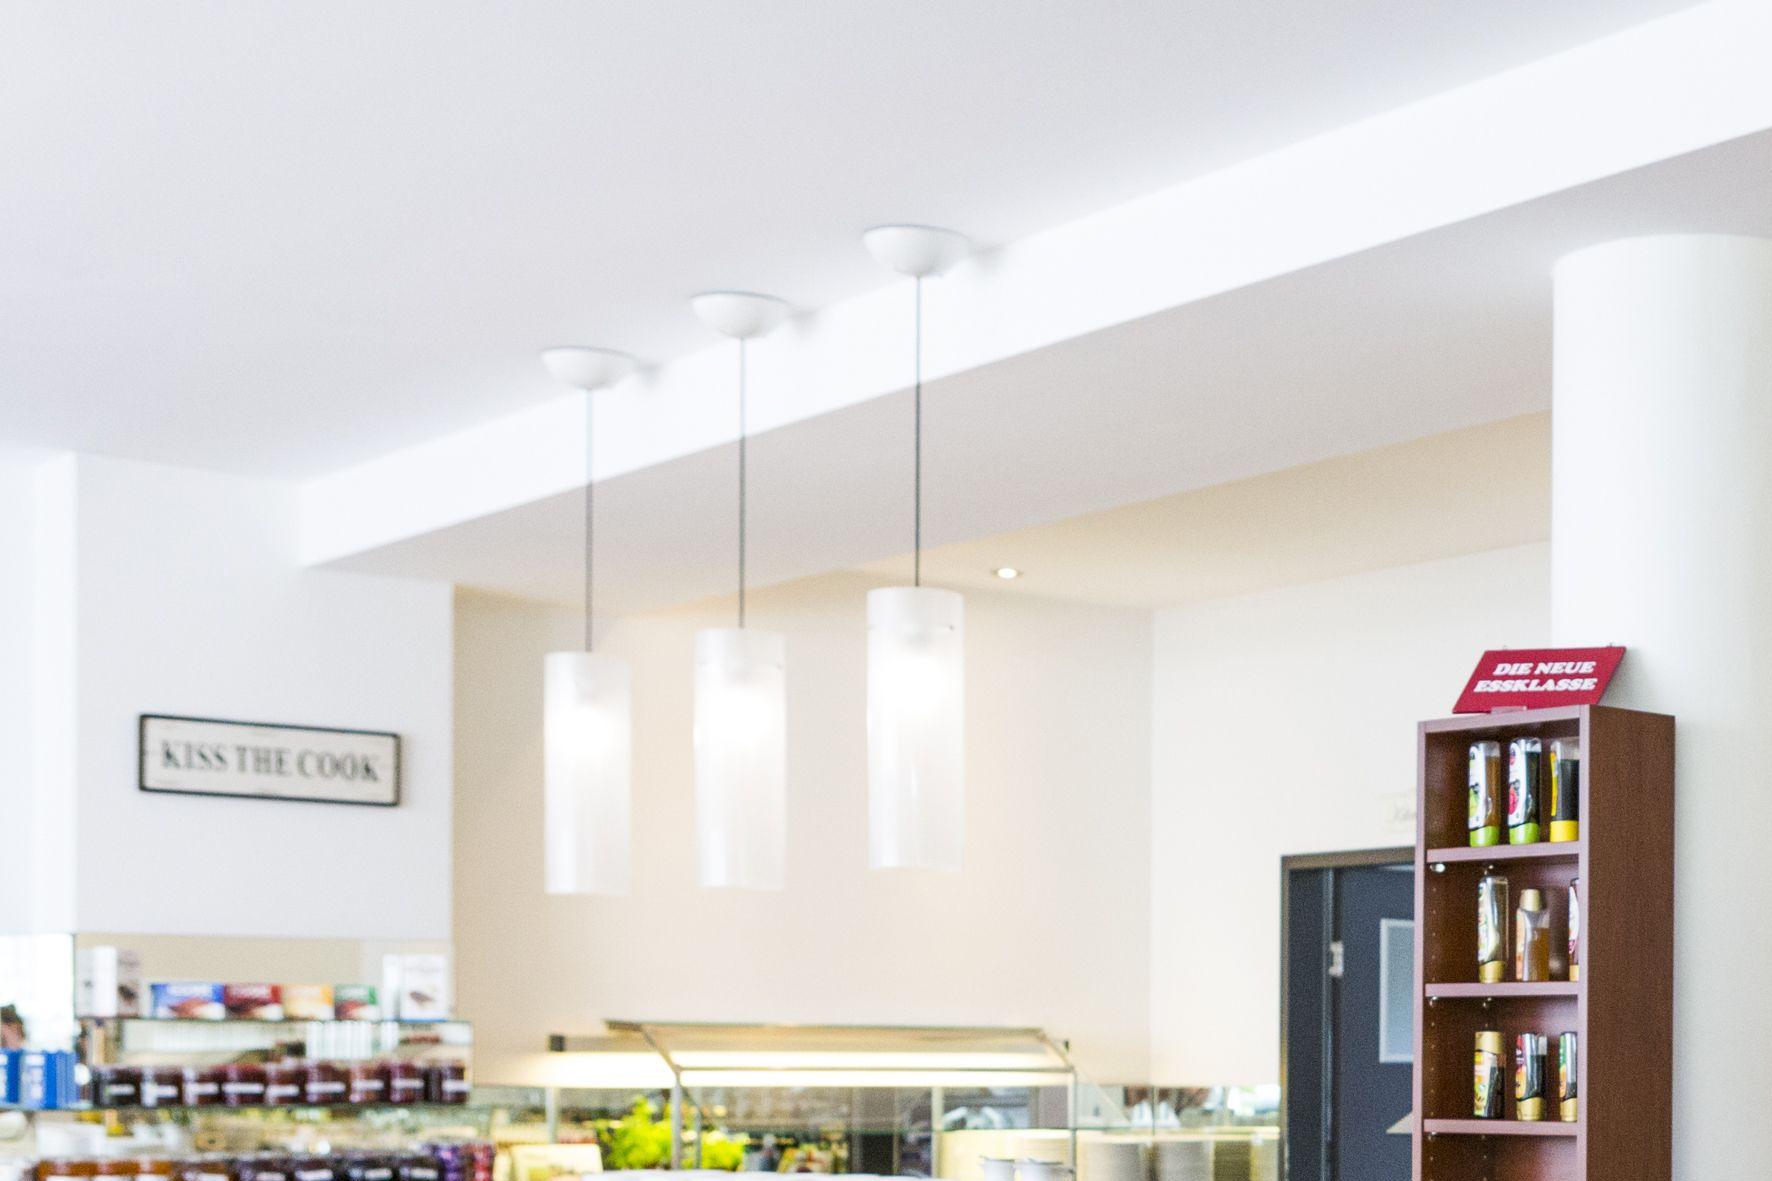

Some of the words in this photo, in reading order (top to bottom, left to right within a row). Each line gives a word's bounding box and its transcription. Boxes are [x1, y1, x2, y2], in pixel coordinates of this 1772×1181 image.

[1493, 662, 1533, 677] DIE
[1534, 661, 1597, 675] NEUE
[1473, 678, 1598, 693] ESSKLASSE
[160, 740, 229, 772] KISS
[235, 744, 292, 776] THE
[298, 748, 381, 783] COOK
